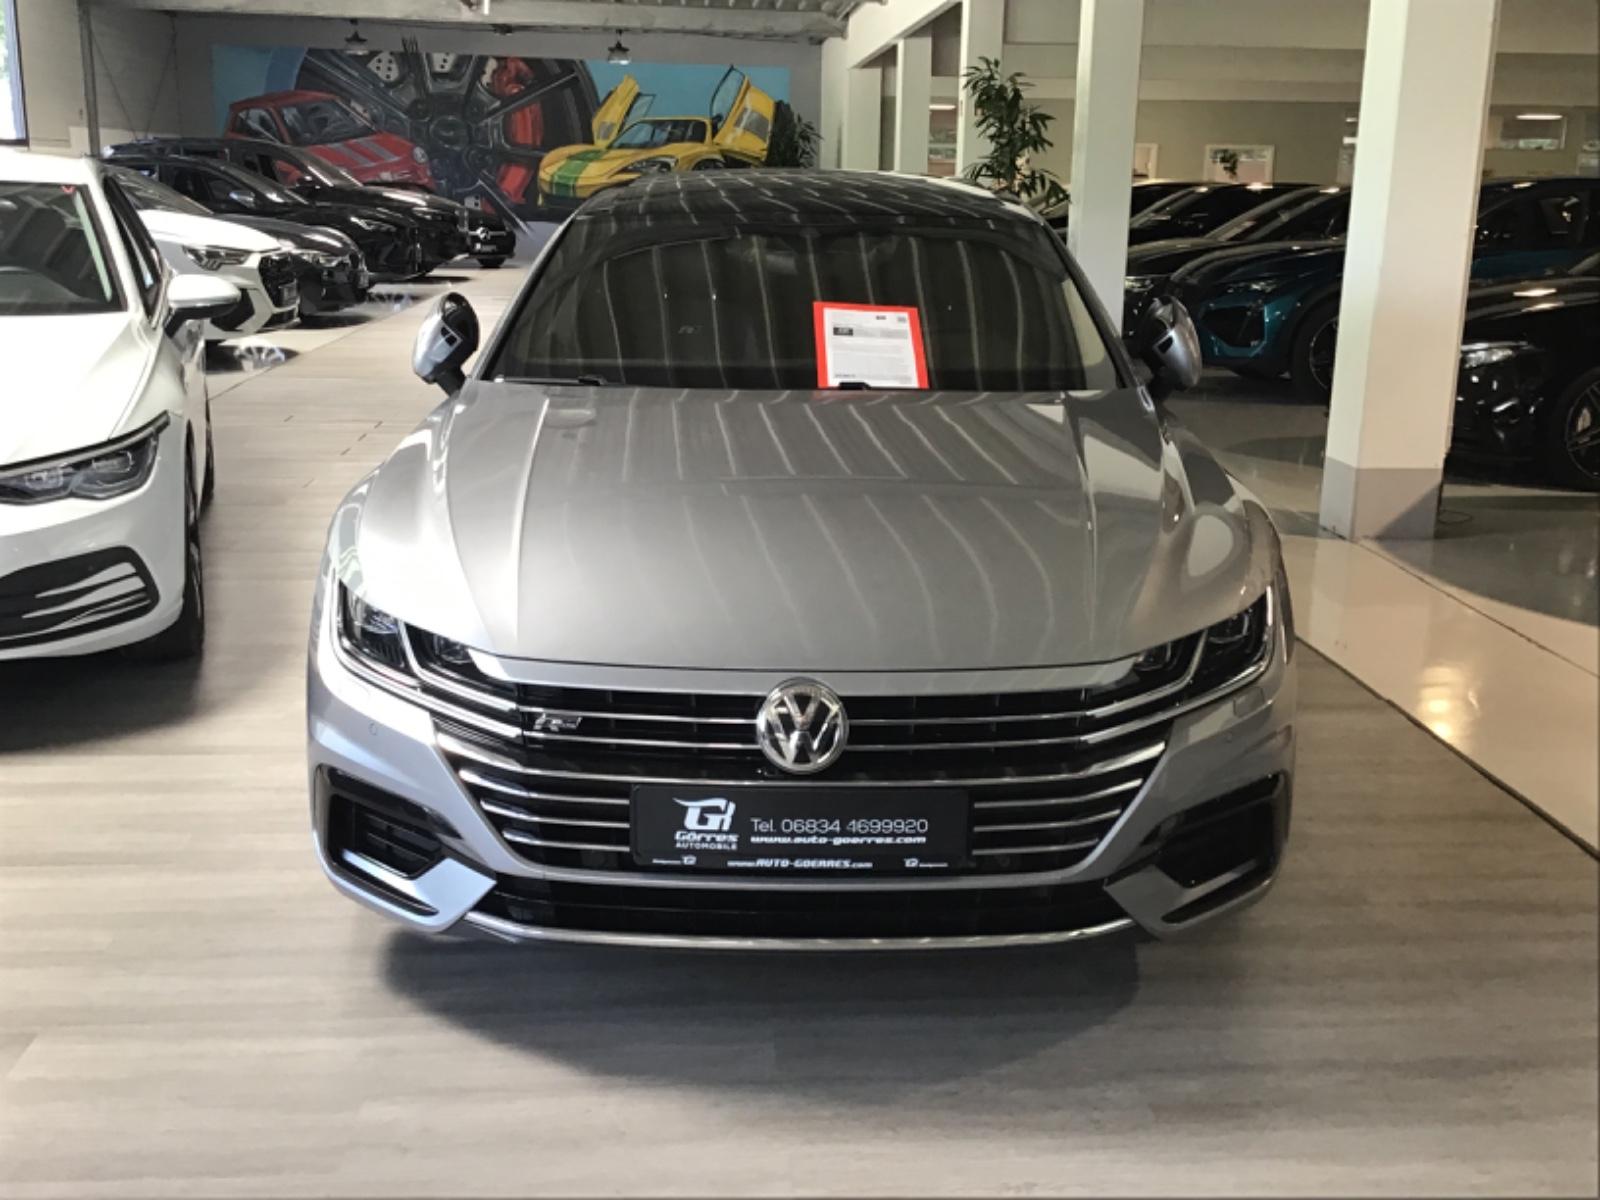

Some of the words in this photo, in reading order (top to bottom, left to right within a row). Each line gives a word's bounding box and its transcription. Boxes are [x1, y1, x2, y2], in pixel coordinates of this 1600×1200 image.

[750, 817, 776, 832] Tel.
[781, 819, 840, 833] 06834
[846, 819, 928, 833] 4699920
[750, 835, 926, 845] www.auto-goerres.com
[675, 842, 738, 851] AUTOMOBILE
